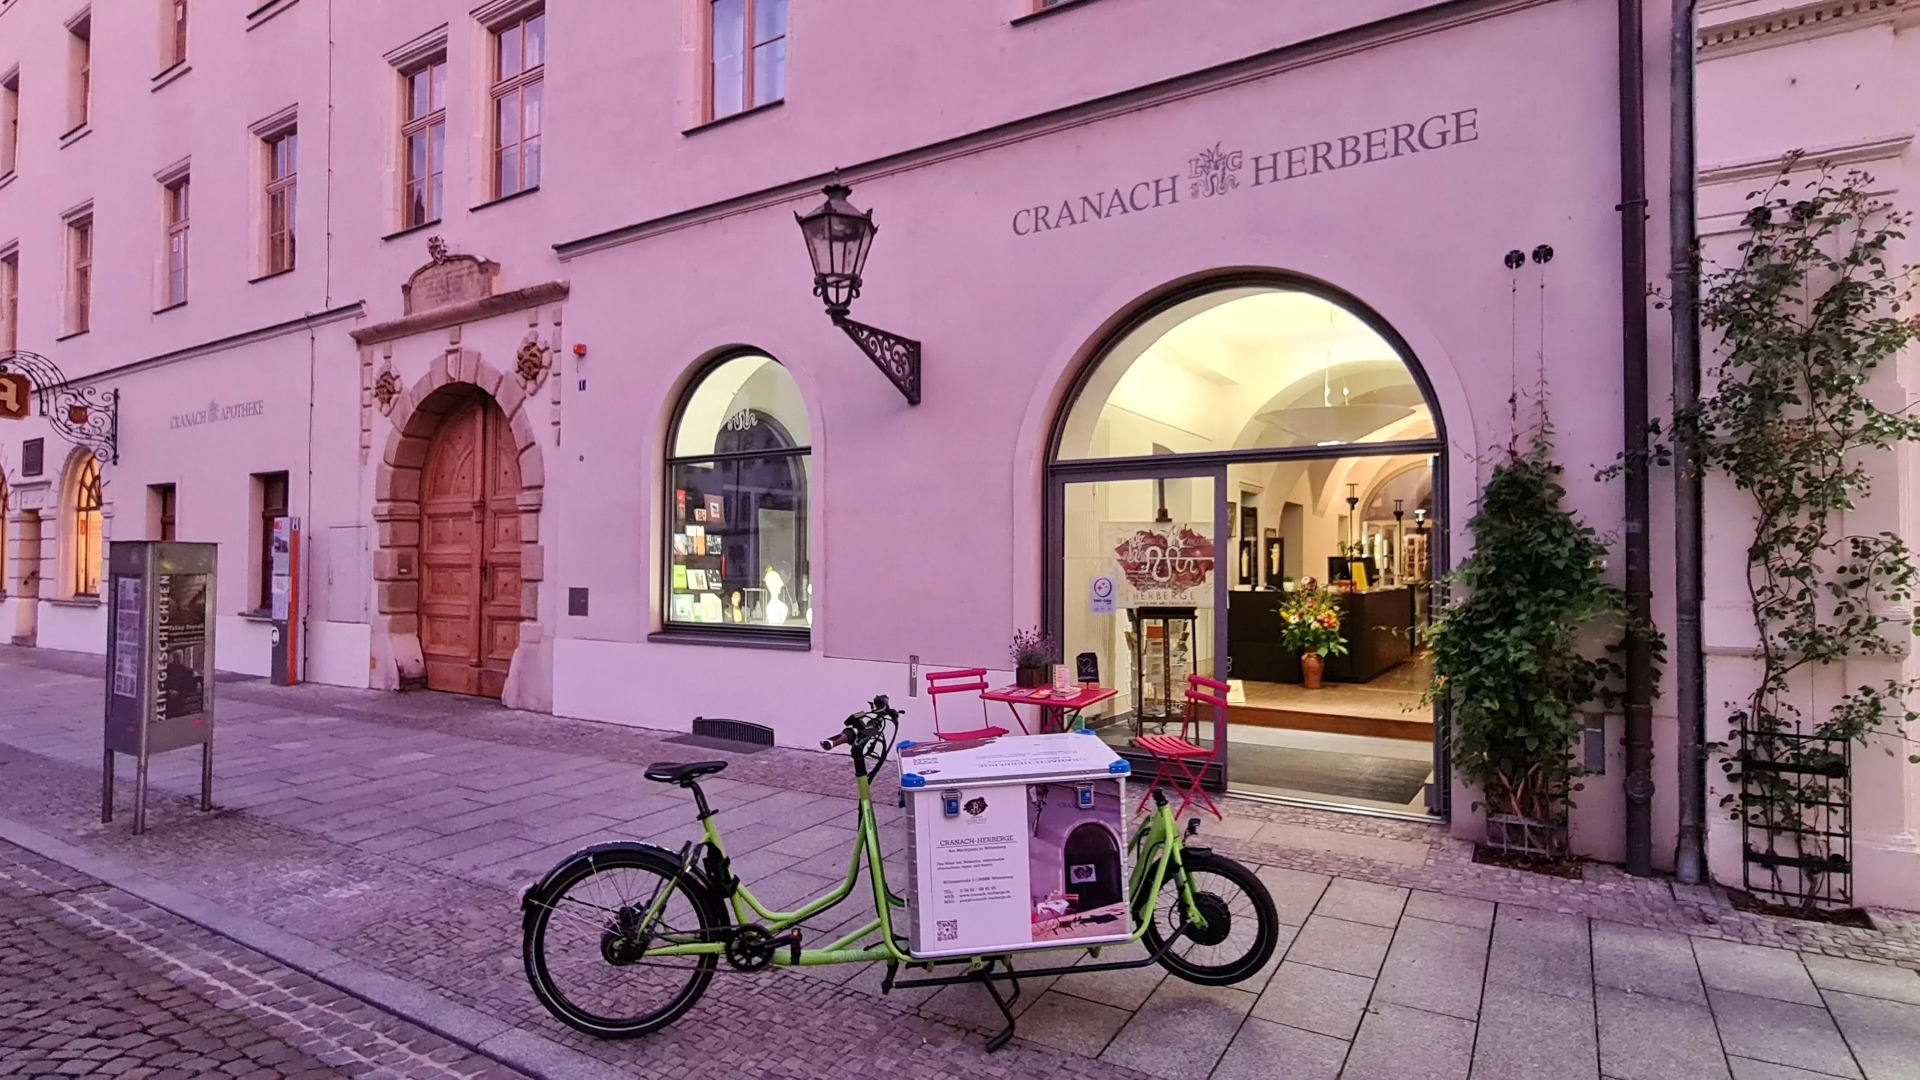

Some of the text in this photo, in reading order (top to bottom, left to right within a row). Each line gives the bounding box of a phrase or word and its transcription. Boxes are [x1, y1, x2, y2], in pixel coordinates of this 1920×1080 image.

[1012, 108, 1480, 236] CRANACH HERBERGE
[169, 399, 264, 429] CRANACH APOTHEKE
[1132, 591, 1196, 600] HERBERGE
[156, 575, 171, 721] ZEIT-GESCHICHTEN
[940, 835, 1013, 846] CRANACH-HERBERGE
